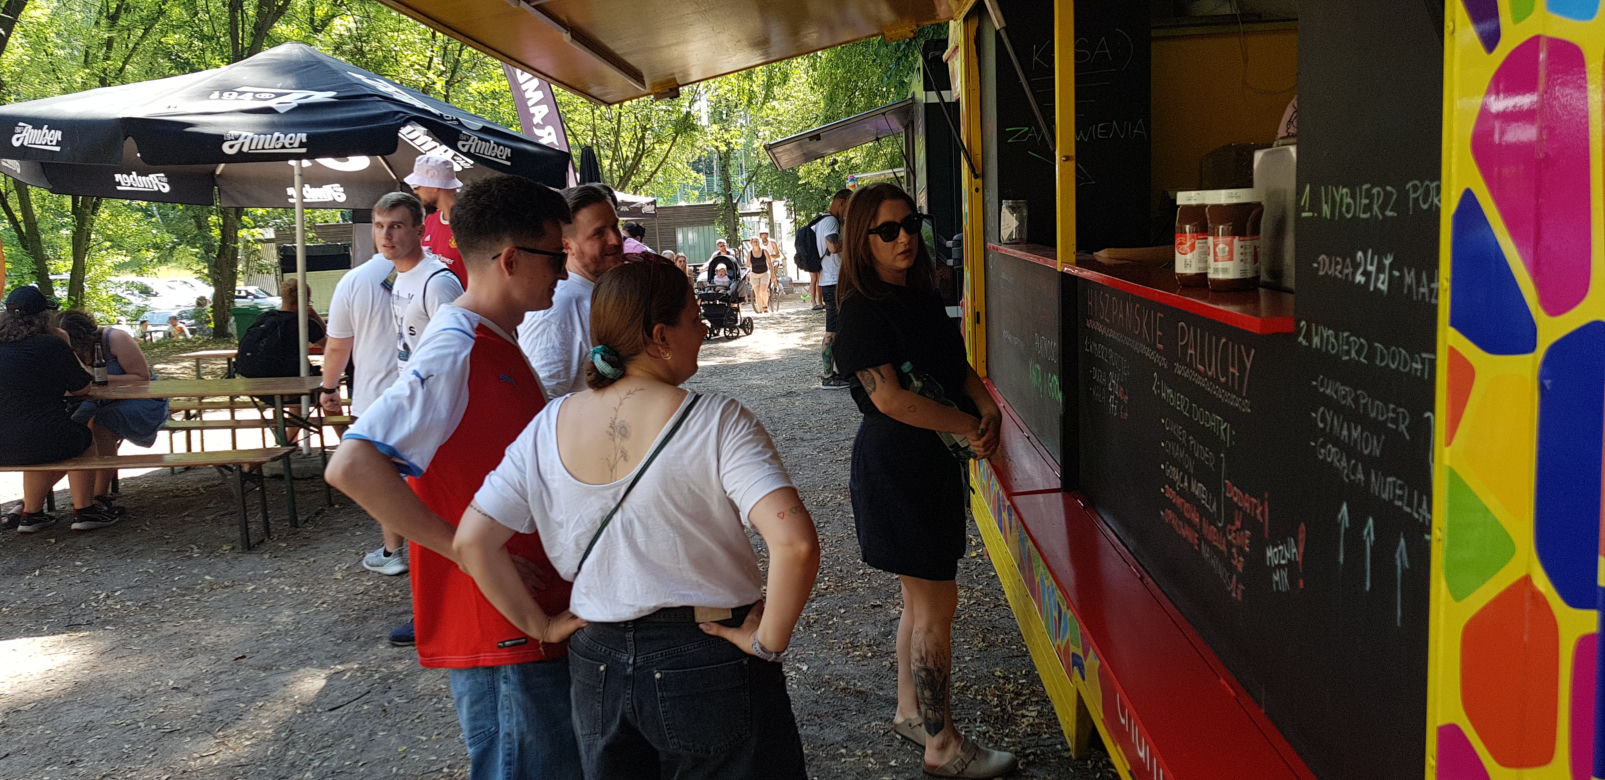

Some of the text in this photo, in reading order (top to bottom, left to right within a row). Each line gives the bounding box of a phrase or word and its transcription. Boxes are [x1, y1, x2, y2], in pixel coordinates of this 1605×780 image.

[1032, 36, 1112, 71] KSA
[11, 121, 62, 151] Amber
[222, 130, 308, 155] Amber
[457, 130, 511, 166] Amber
[1005, 118, 1148, 146] ZAMWIENIA
[1321, 183, 1398, 220] WYBIERZ
[1178, 321, 1256, 397] PALUCHY
[1312, 322, 1368, 365] WYBIERZ
[1356, 389, 1411, 440] PUDER
[1272, 567, 1290, 592] MIX
